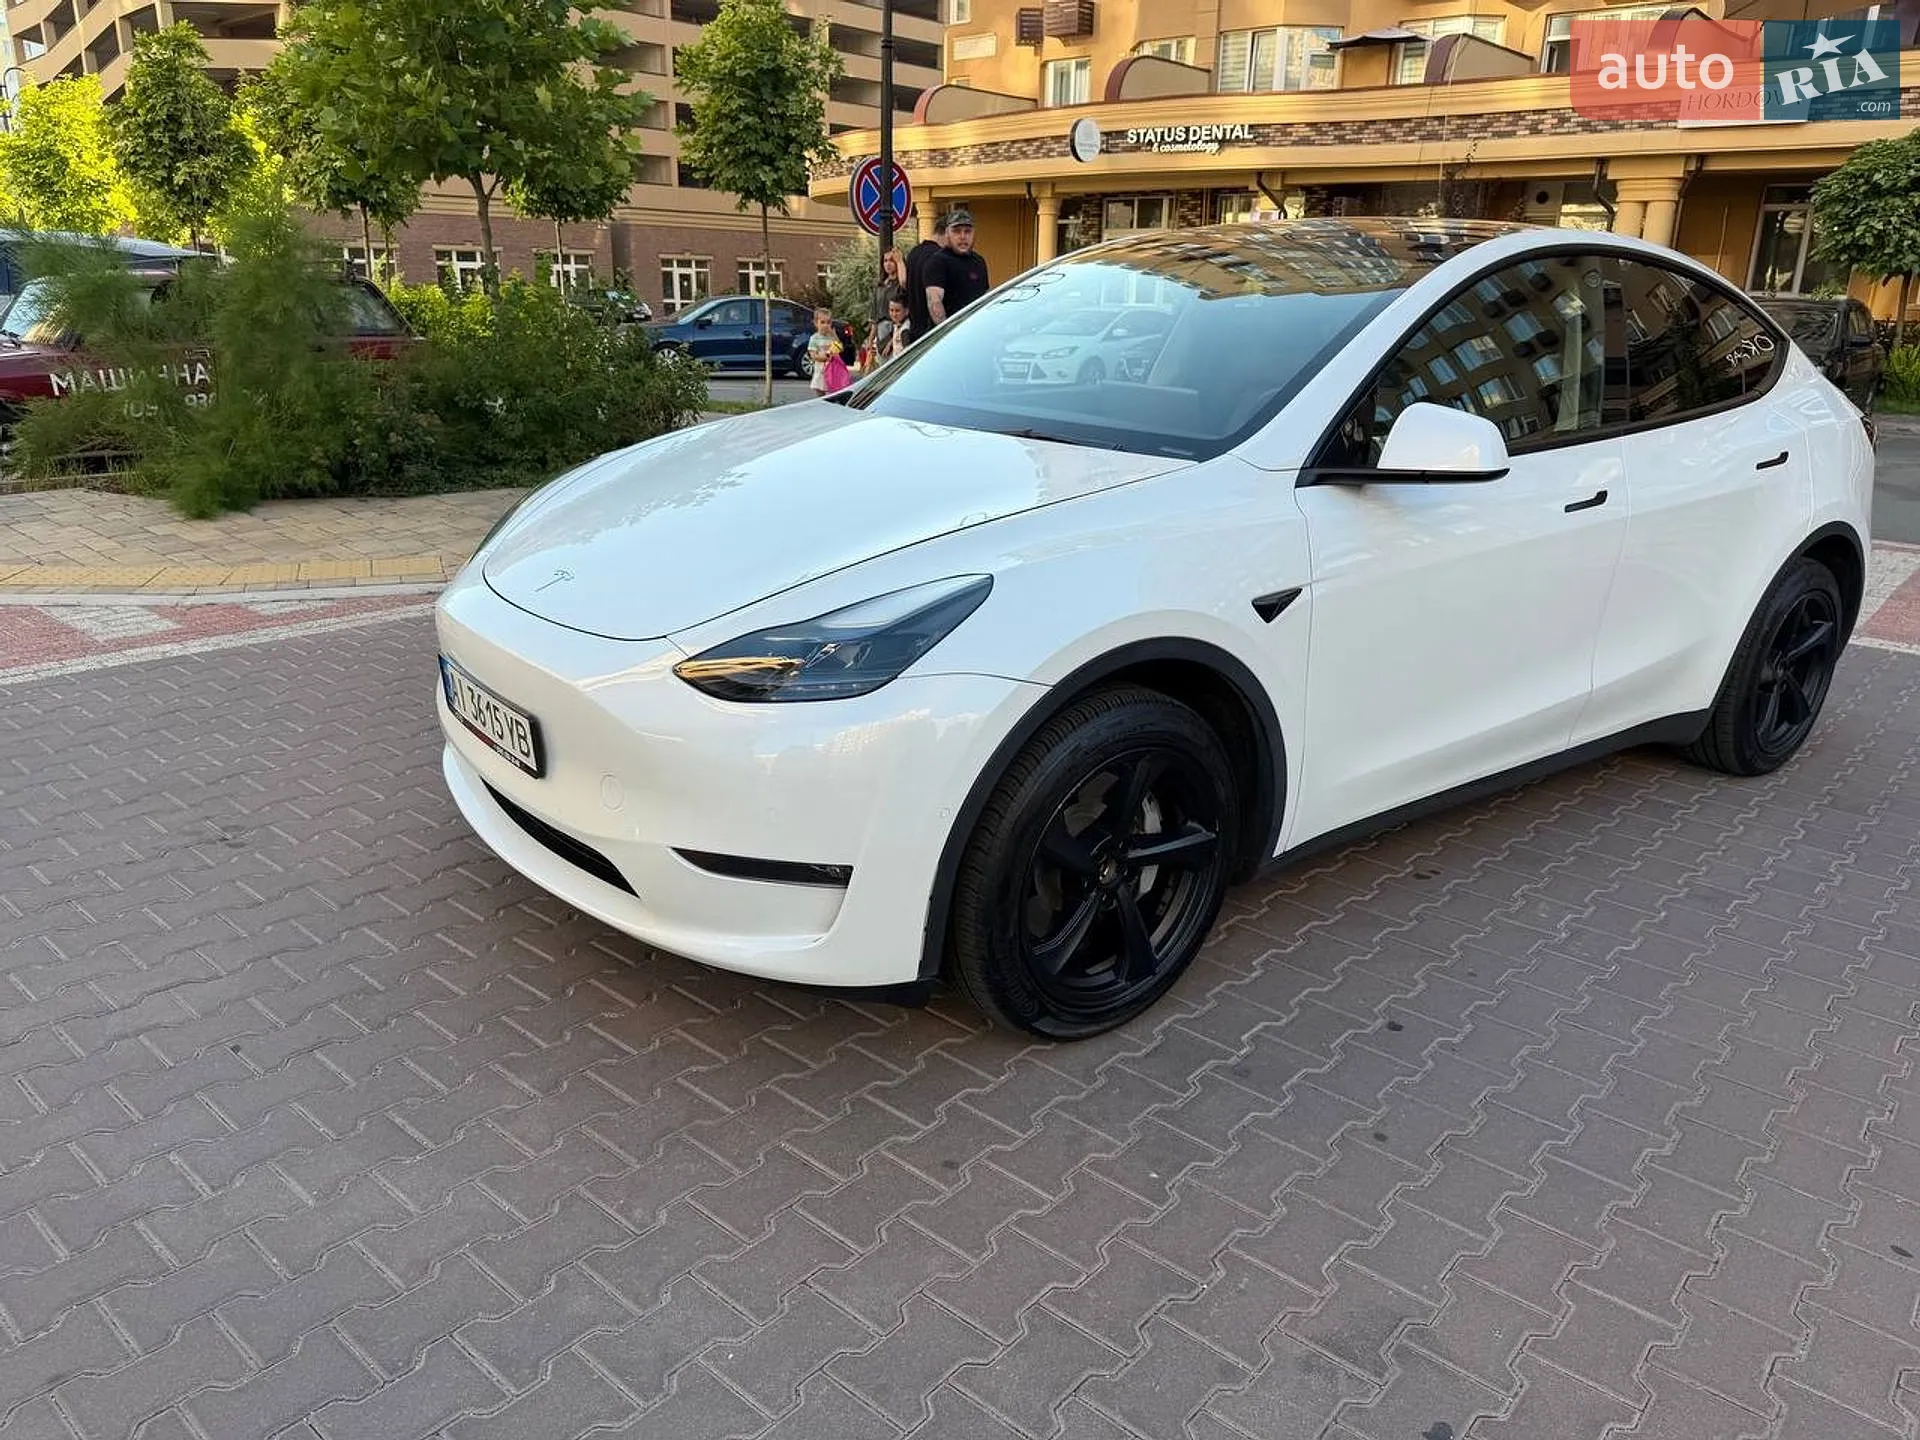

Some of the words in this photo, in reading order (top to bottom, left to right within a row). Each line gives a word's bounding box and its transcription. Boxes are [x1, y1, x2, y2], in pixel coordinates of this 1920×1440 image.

[1127, 126, 1186, 144] STATUS
[1189, 124, 1254, 141] DENTAL
[467, 685, 504, 740] 3615
[504, 711, 531, 759] YB
